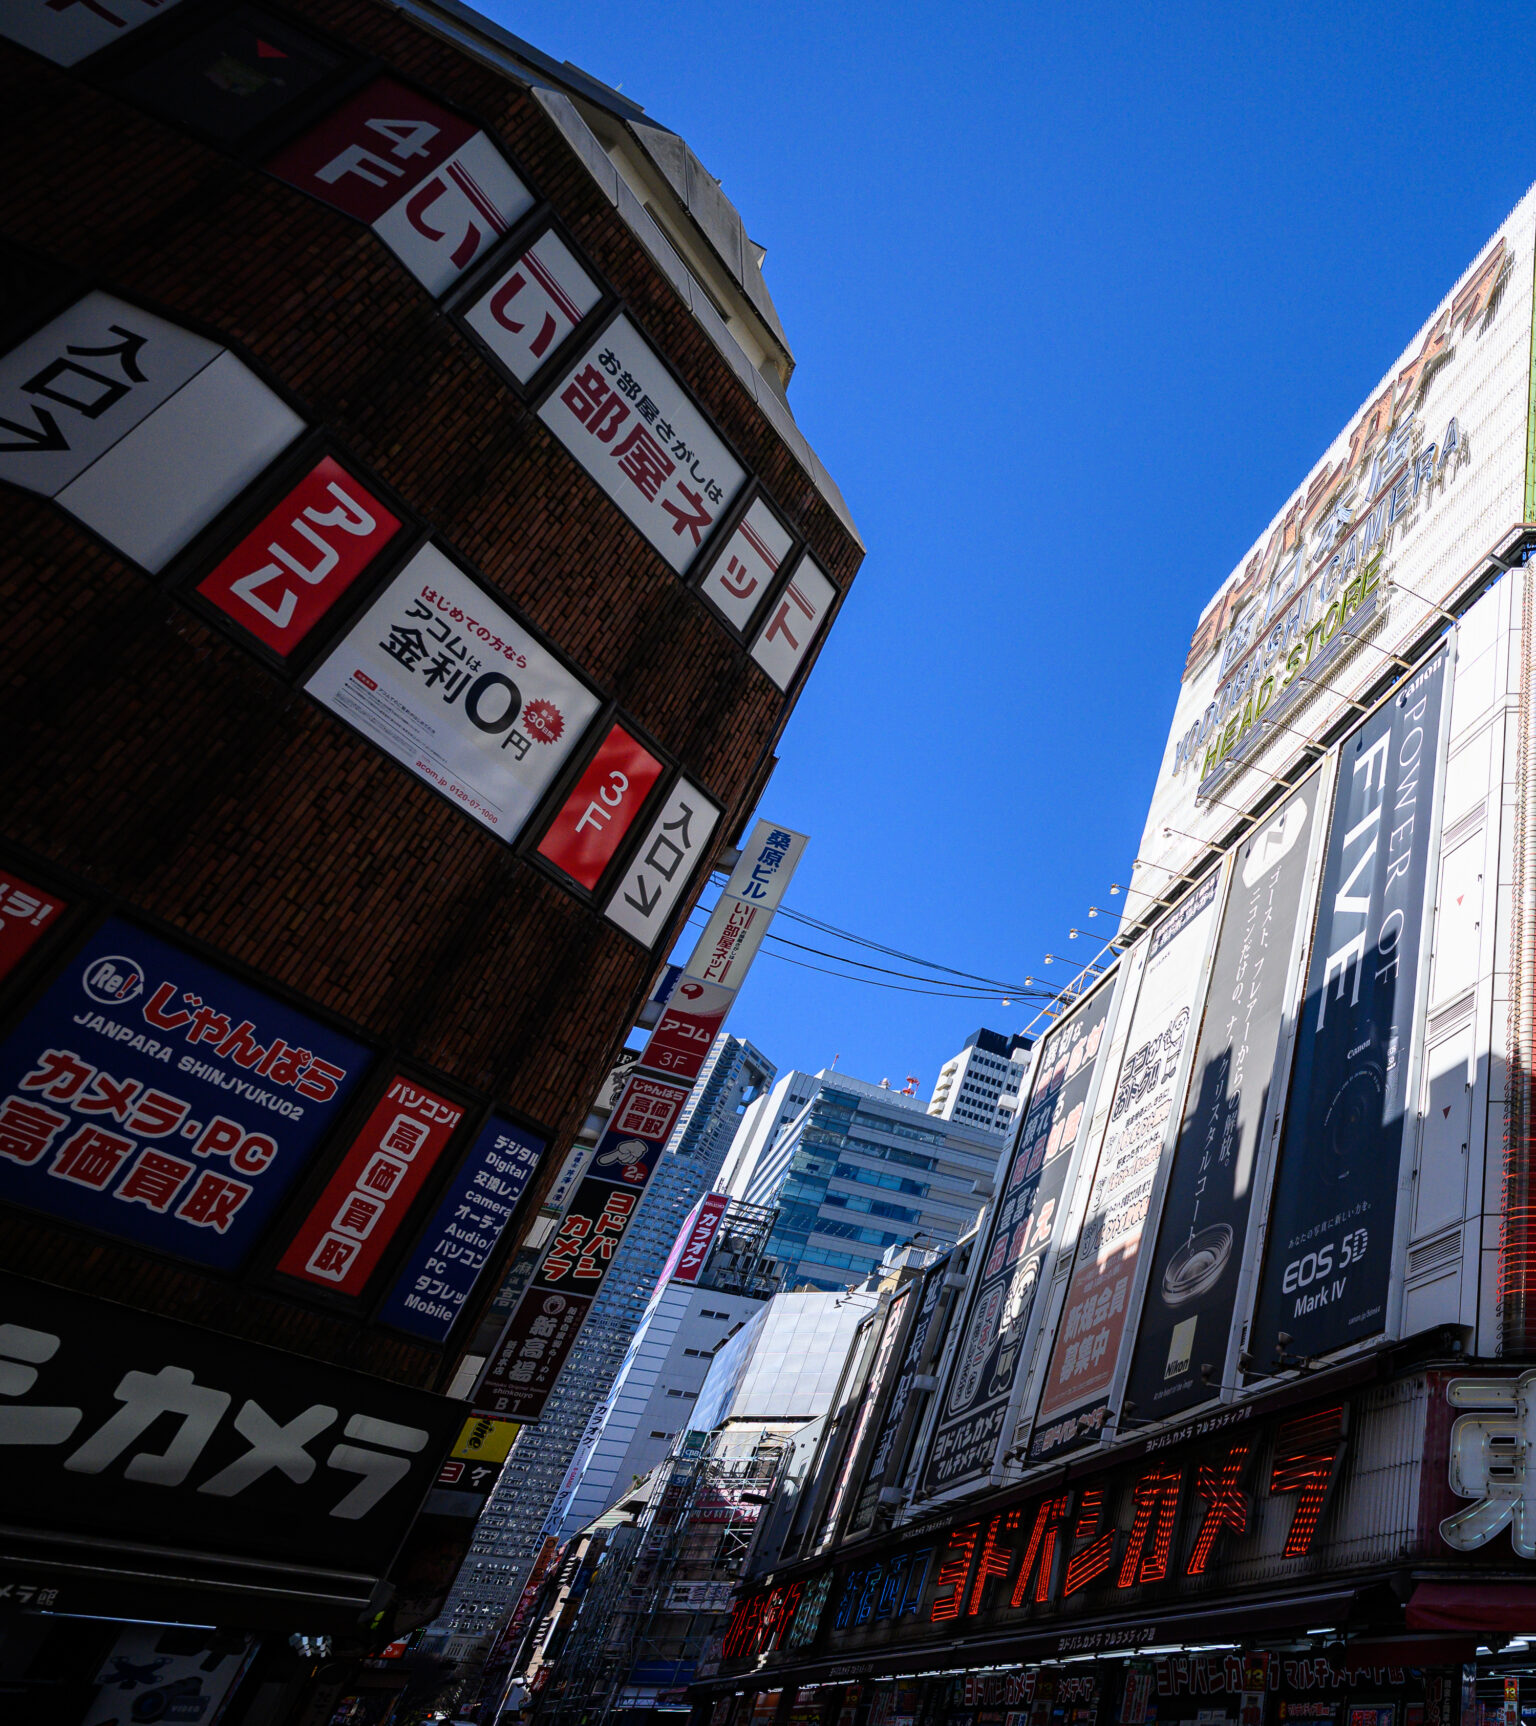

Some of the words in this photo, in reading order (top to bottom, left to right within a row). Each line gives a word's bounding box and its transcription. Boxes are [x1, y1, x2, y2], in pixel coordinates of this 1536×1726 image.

[314, 117, 442, 188] 4F
[20, 324, 150, 420] 入口
[597, 347, 724, 506] お部屋さがしは
[1181, 237, 1506, 683] ヨドバシカメラ
[1320, 416, 1460, 604] CAMERA
[229, 480, 378, 630] アコム
[404, 598, 483, 673] アコムは
[421, 585, 528, 669] はじめての方なら
[1200, 675, 1276, 782] HEAD
[1282, 548, 1385, 688] STORE
[1395, 654, 1444, 707] Canon
[416, 760, 449, 788] acom.jp
[449, 784, 499, 825] 0120-07-1000
[574, 769, 629, 834] 3F
[1385, 696, 1427, 896] POWER
[645, 801, 694, 882] 入口
[741, 828, 792, 900] 桑原ビル
[1315, 725, 1392, 1035] FIVE
[702, 902, 750, 981] いい部屋ネット
[1374, 922, 1405, 985] OF
[142, 980, 347, 1103] じゃんぱら
[658, 1051, 689, 1070] 3F
[660, 1017, 712, 1044] アコム
[1347, 1038, 1371, 1061] Canon
[72, 1011, 174, 1063] JANPARA
[177, 1054, 306, 1122] SHINJYUKU02
[632, 1079, 686, 1103] じゃんぱら
[0, 1094, 254, 1235] 高価買取
[306, 1114, 430, 1281] 高価買取
[485, 1151, 528, 1181] Digital
[623, 1165, 645, 1182] 2F
[424, 1256, 449, 1276] PC
[541, 1213, 592, 1282] カメラ
[572, 1190, 636, 1280] ヨドバシ
[681, 1212, 719, 1269] カラオケ
[1281, 1243, 1334, 1296] EOS
[1338, 1227, 1369, 1270] 5D
[403, 1293, 454, 1322] Mobile
[1062, 1275, 1129, 1343] 新規会員
[1292, 1286, 1328, 1320] Mark
[1330, 1276, 1348, 1303] IV
[1059, 1325, 1111, 1385] 募集中
[1165, 1357, 1190, 1379] Nikon
[932, 1404, 1008, 1462] ヨドバシカメラ
[930, 1406, 1346, 1624] ヨドバシカメラ
[1155, 1655, 1280, 1693] ヨドバシカラ
